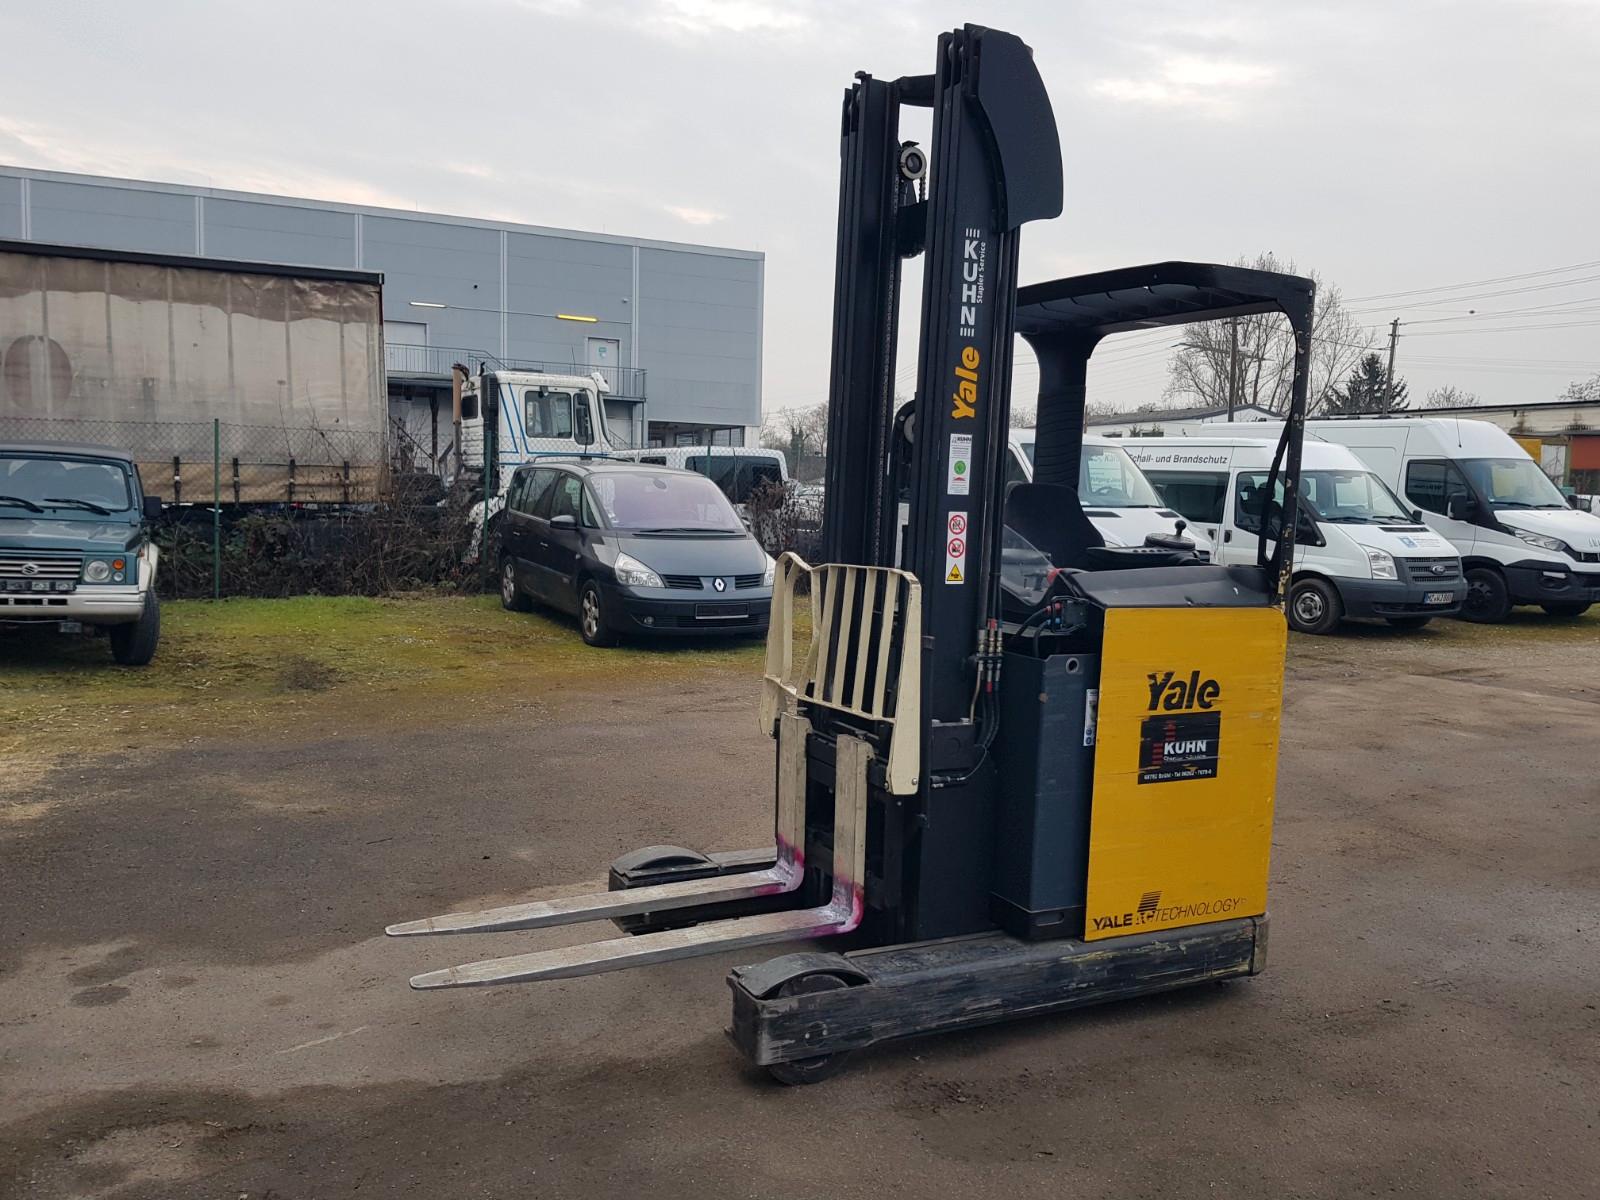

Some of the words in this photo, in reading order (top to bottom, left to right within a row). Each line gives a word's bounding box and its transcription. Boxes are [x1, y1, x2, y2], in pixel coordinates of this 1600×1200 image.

[979, 241, 987, 272] Service
[960, 239, 979, 326] KUHN
[976, 272, 985, 304] Stapler
[951, 346, 980, 419] Yale
[1155, 454, 1171, 463] und
[1173, 454, 1228, 464] Brandschutz
[1147, 670, 1220, 711] Yale
[1164, 740, 1207, 755] KUHN
[1093, 913, 1133, 931] YALE
[1153, 898, 1240, 922] TECHNOLOGY
